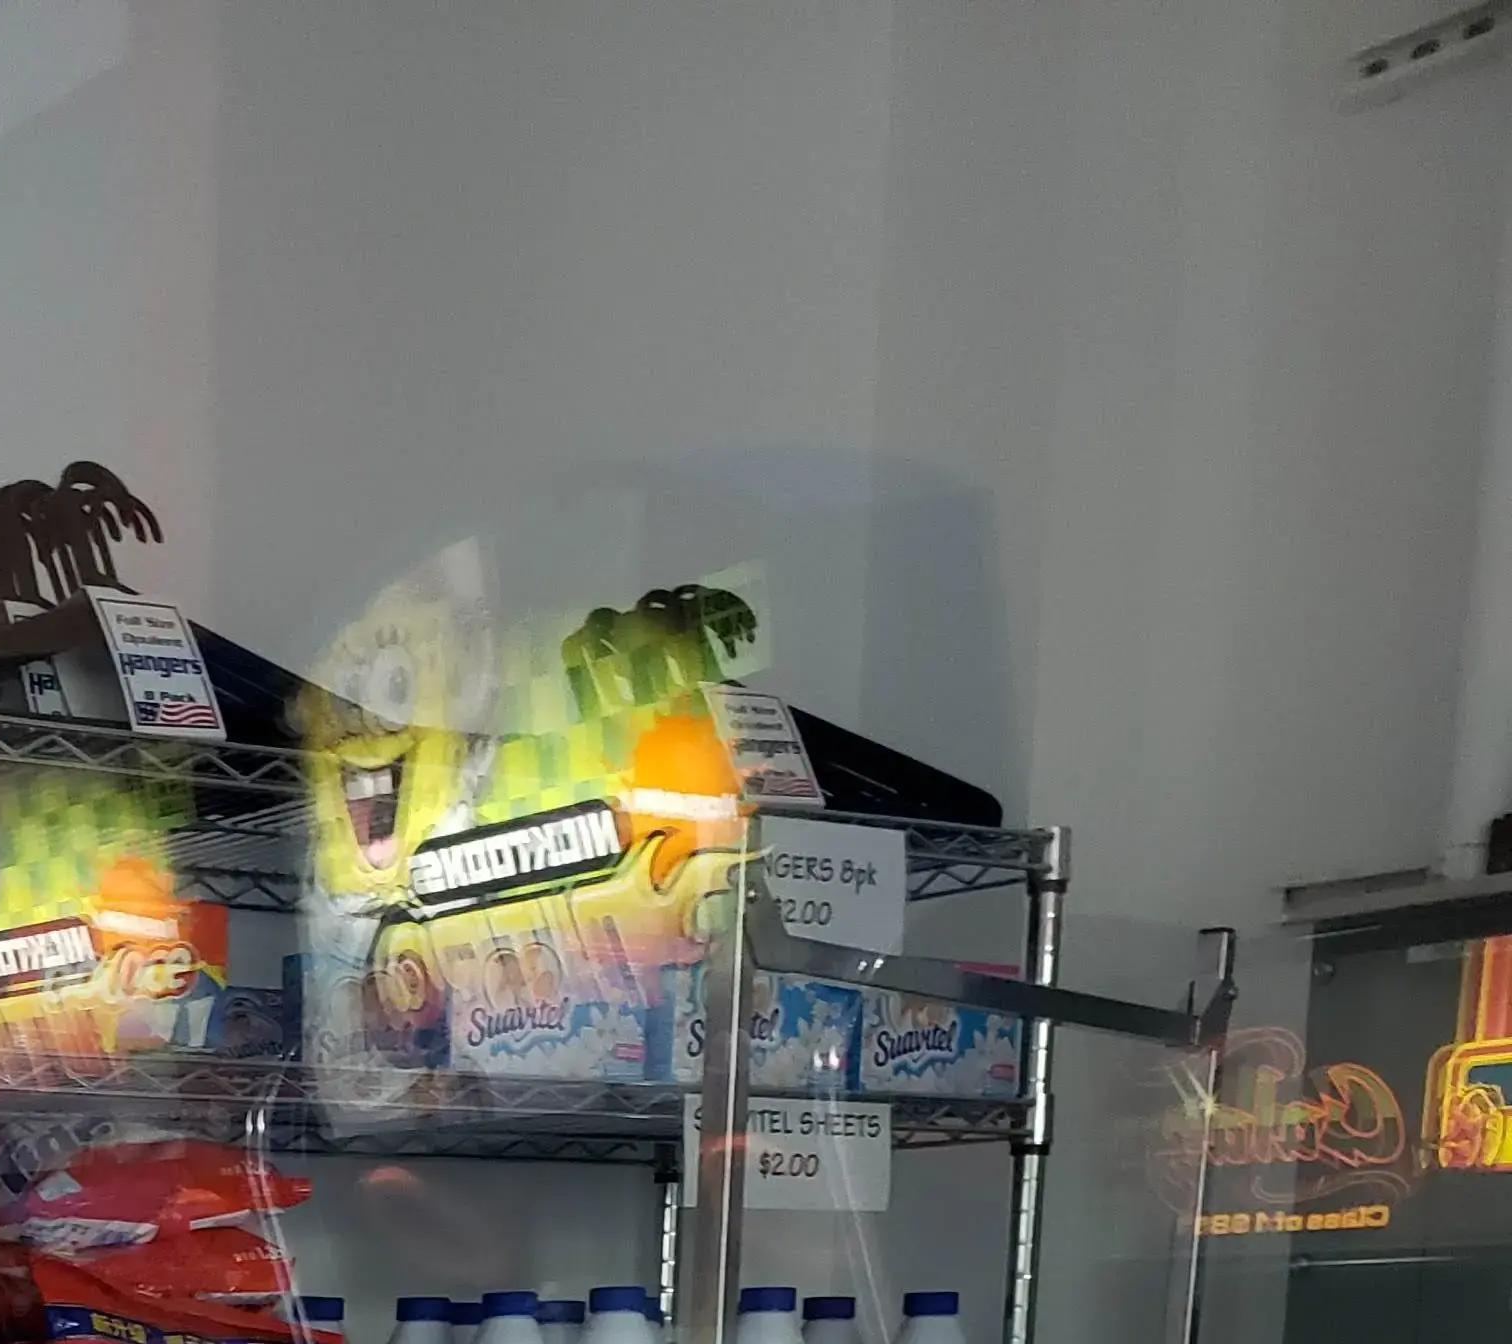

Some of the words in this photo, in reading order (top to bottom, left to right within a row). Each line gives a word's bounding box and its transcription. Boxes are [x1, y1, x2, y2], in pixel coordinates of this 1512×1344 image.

[118, 652, 203, 678] Hangers
[767, 854, 835, 882] NGERS
[839, 859, 878, 894] 8pk
[775, 898, 832, 926] 2.00
[874, 1020, 959, 1067] Suavitel
[799, 1110, 882, 1139] SHEETS
[759, 1152, 820, 1179] $2.00
